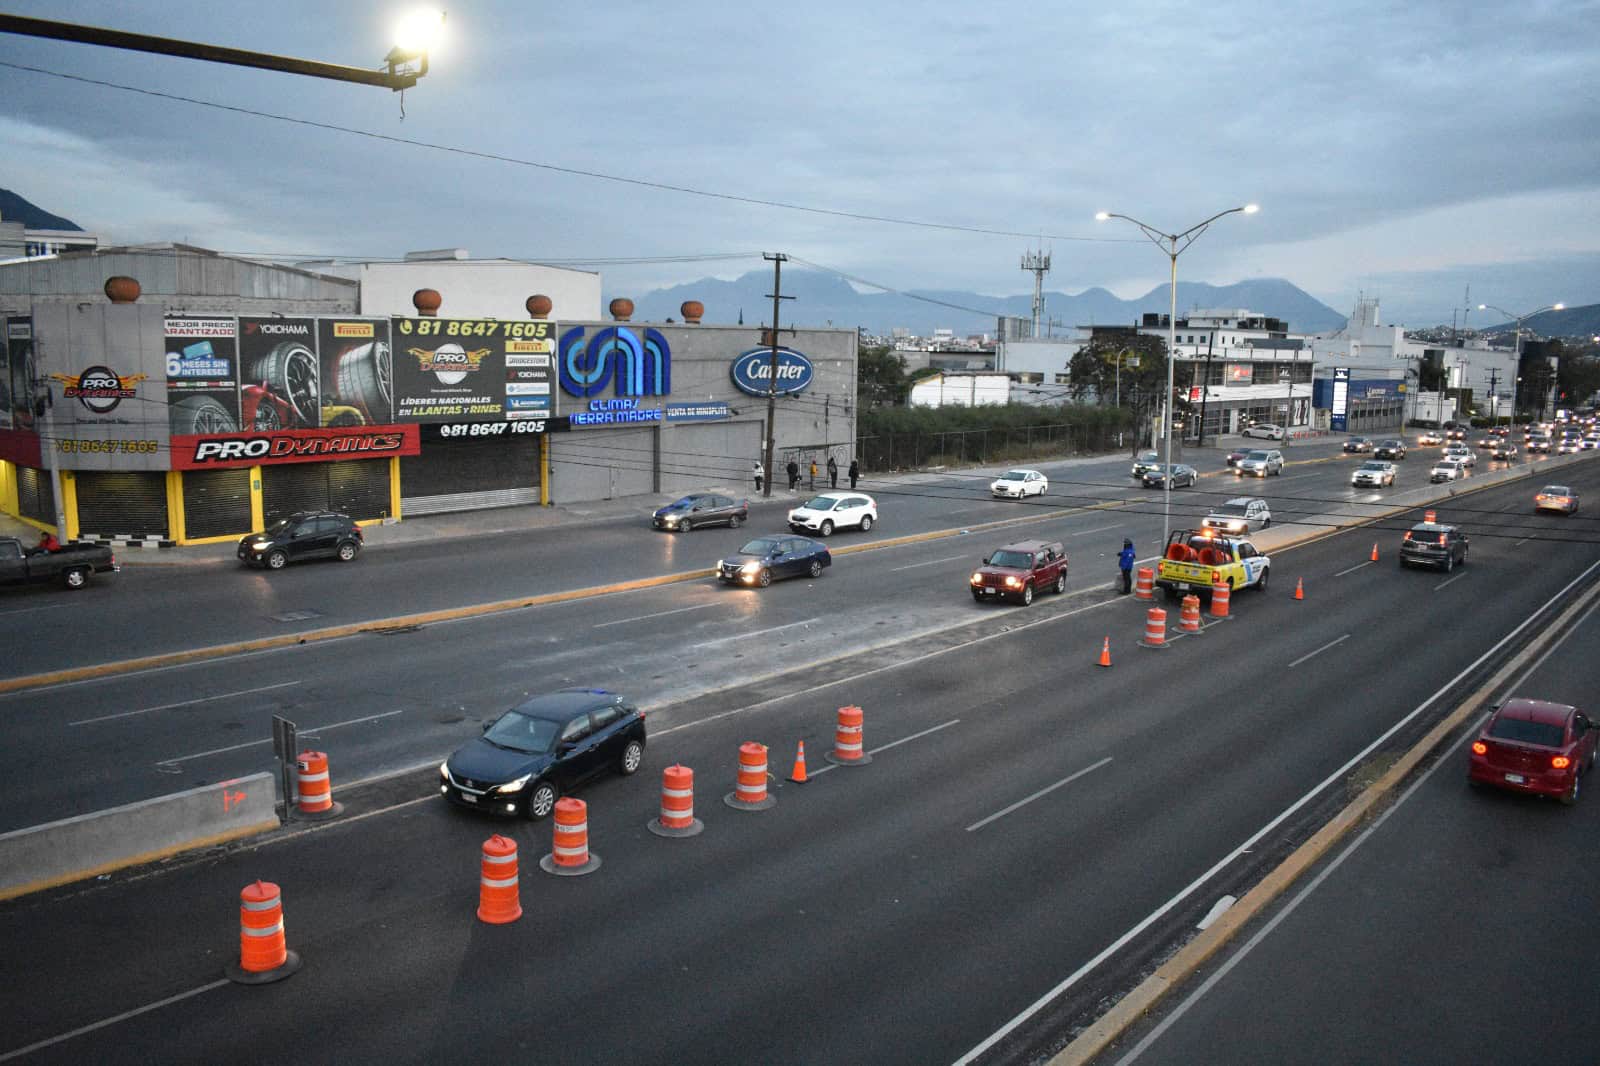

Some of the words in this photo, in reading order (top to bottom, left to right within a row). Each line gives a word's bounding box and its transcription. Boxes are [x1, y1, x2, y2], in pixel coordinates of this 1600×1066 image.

[260, 324, 309, 334] YOKOHAMA
[337, 325, 371, 335] PIRELLI
[417, 320, 442, 336] 81
[446, 321, 498, 336] 8647
[503, 323, 548, 337] 1605
[436, 352, 468, 363] PRO
[165, 352, 181, 377] 6
[746, 359, 806, 379] Carrier
[83, 379, 118, 389] PRO
[438, 396, 491, 404] NACIONALES
[399, 408, 412, 416] EN
[412, 405, 463, 416] LLANTAS
[470, 404, 503, 414] RINES
[449, 425, 468, 437] 81
[469, 423, 508, 436] 8647
[511, 421, 546, 433] 1605
[196, 439, 270, 460] PRO
[270, 434, 402, 457] DYNAMICS
